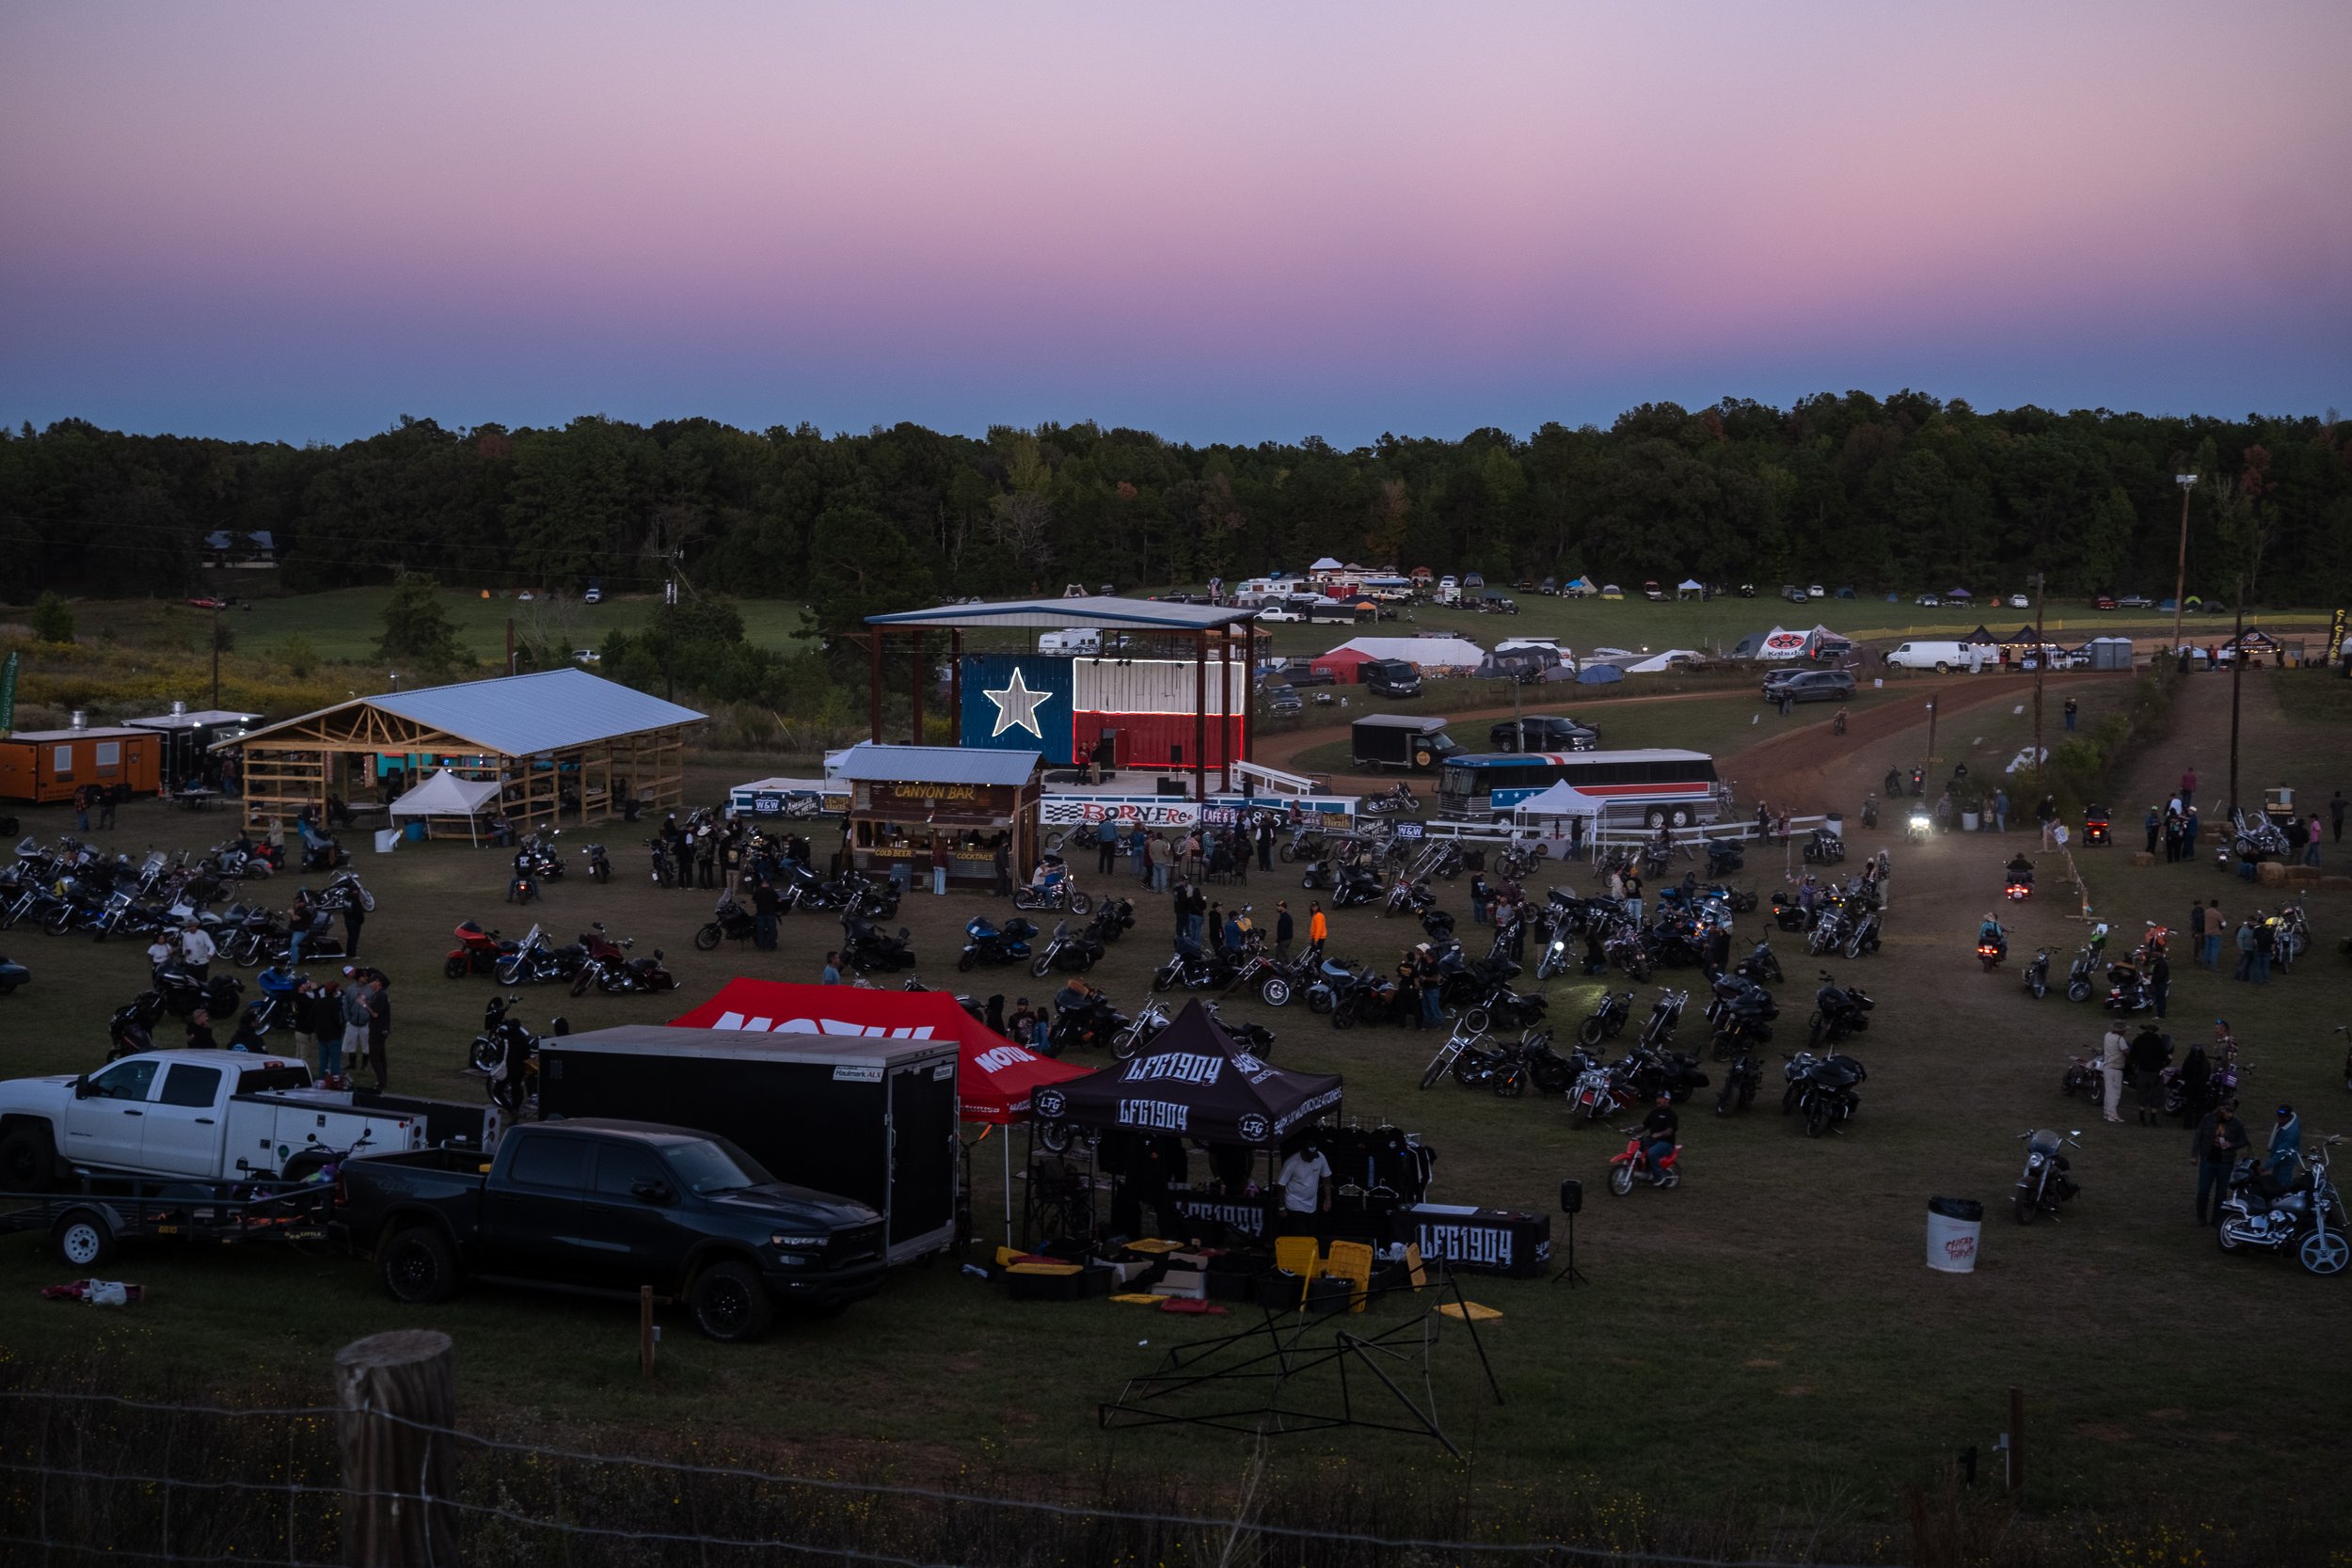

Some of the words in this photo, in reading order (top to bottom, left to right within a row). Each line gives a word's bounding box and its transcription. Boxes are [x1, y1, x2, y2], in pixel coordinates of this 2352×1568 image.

[895, 785, 945, 798] CANYON
[947, 787, 975, 800] BAR
[755, 802, 779, 811] W&W
[787, 797, 814, 814] AMERICAN
[801, 802, 818, 816] METAL
[1203, 809, 1221, 823] CAFE
[1223, 813, 1229, 823] &
[1252, 812, 1282, 827] 85
[1357, 819, 1384, 835] AMERICAN
[1372, 825, 1390, 839] METAL
[1398, 827, 1422, 835] W&W
[974, 1046, 1038, 1073] MOTUL
[1123, 1053, 1224, 1086] LFG1904
[1041, 1097, 1061, 1110] LFG
[1118, 1099, 1190, 1133] LFG1904
[1243, 1120, 1265, 1134] LFG
[1415, 1224, 1514, 1269] LFG1904
